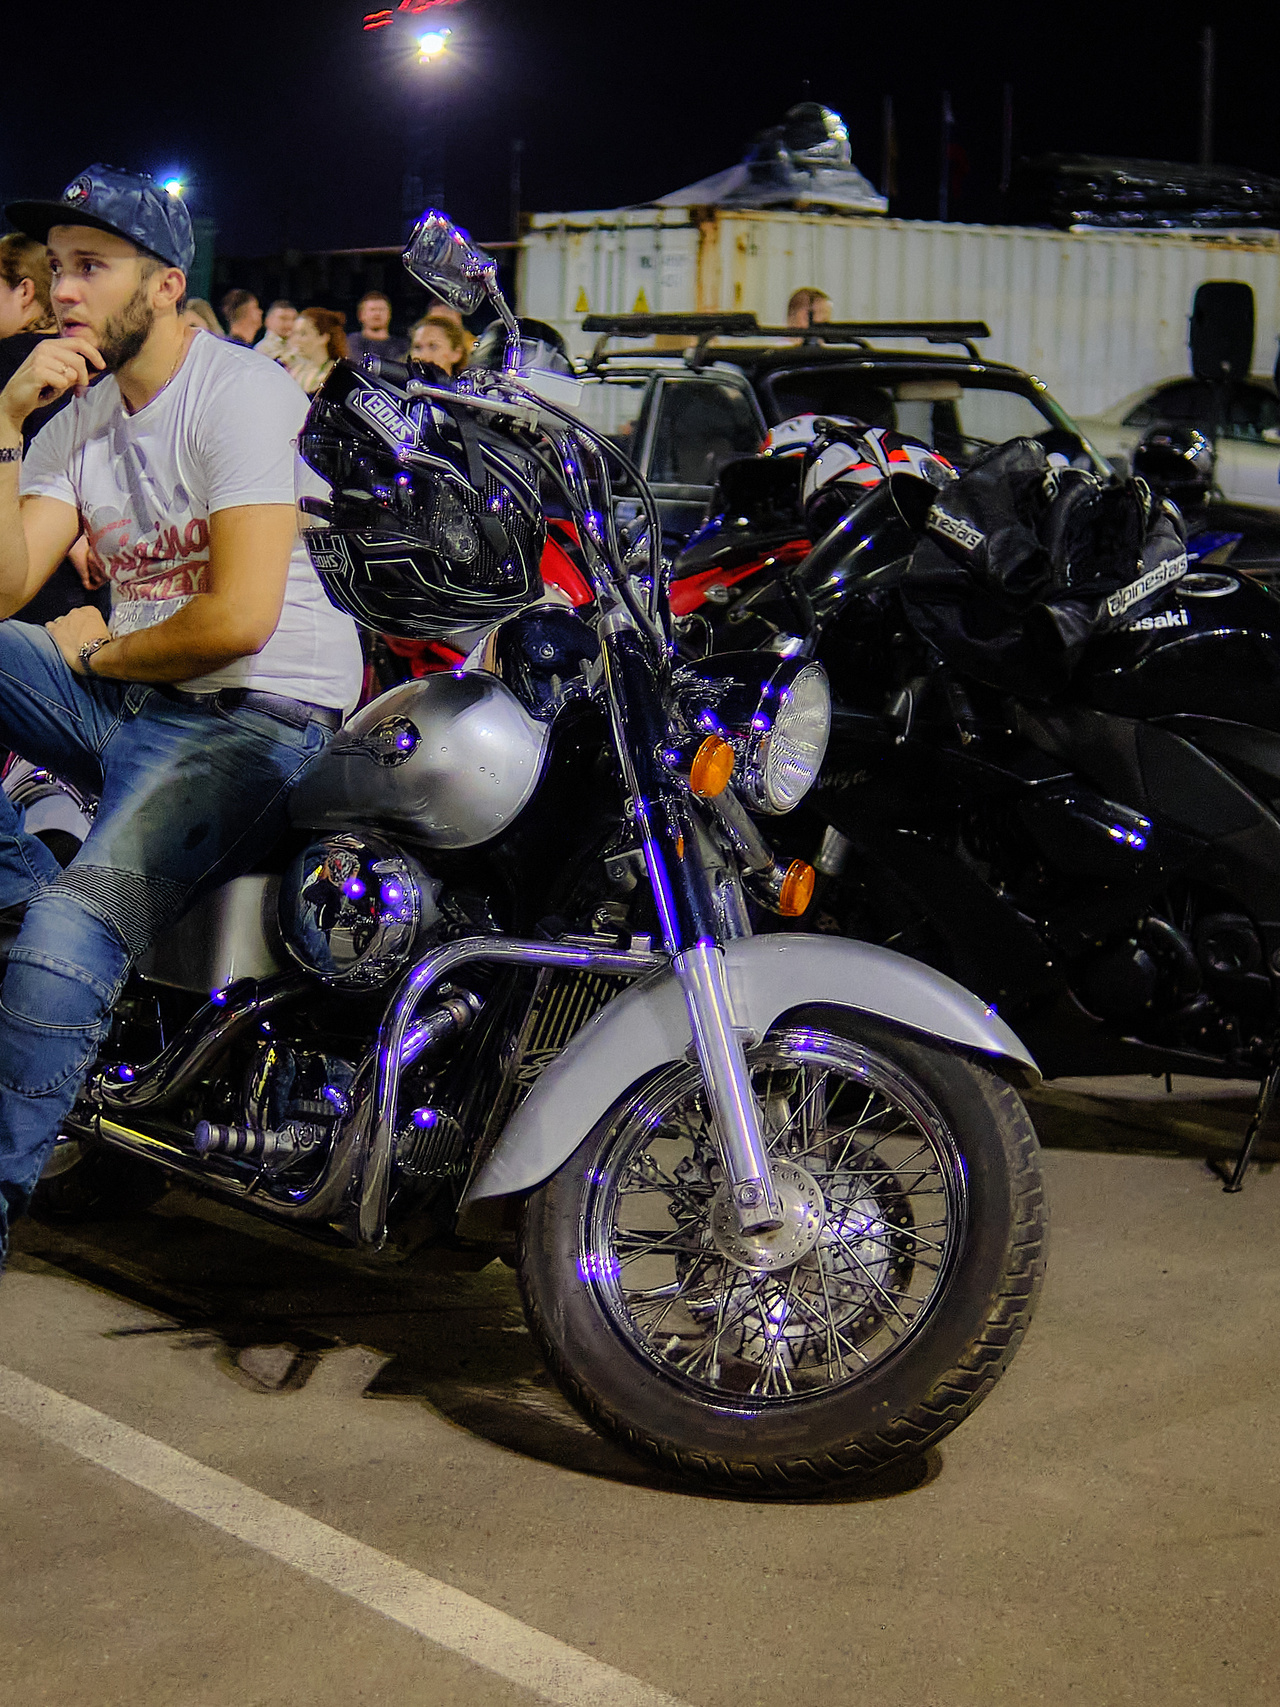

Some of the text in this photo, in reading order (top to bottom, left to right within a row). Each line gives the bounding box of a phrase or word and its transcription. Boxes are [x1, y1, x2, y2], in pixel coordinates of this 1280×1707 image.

[363, 394, 413, 441] SHOEI
[311, 554, 339, 568] SHOE
[1108, 558, 1187, 612] alpinestars
[1127, 609, 1189, 632] asaki
